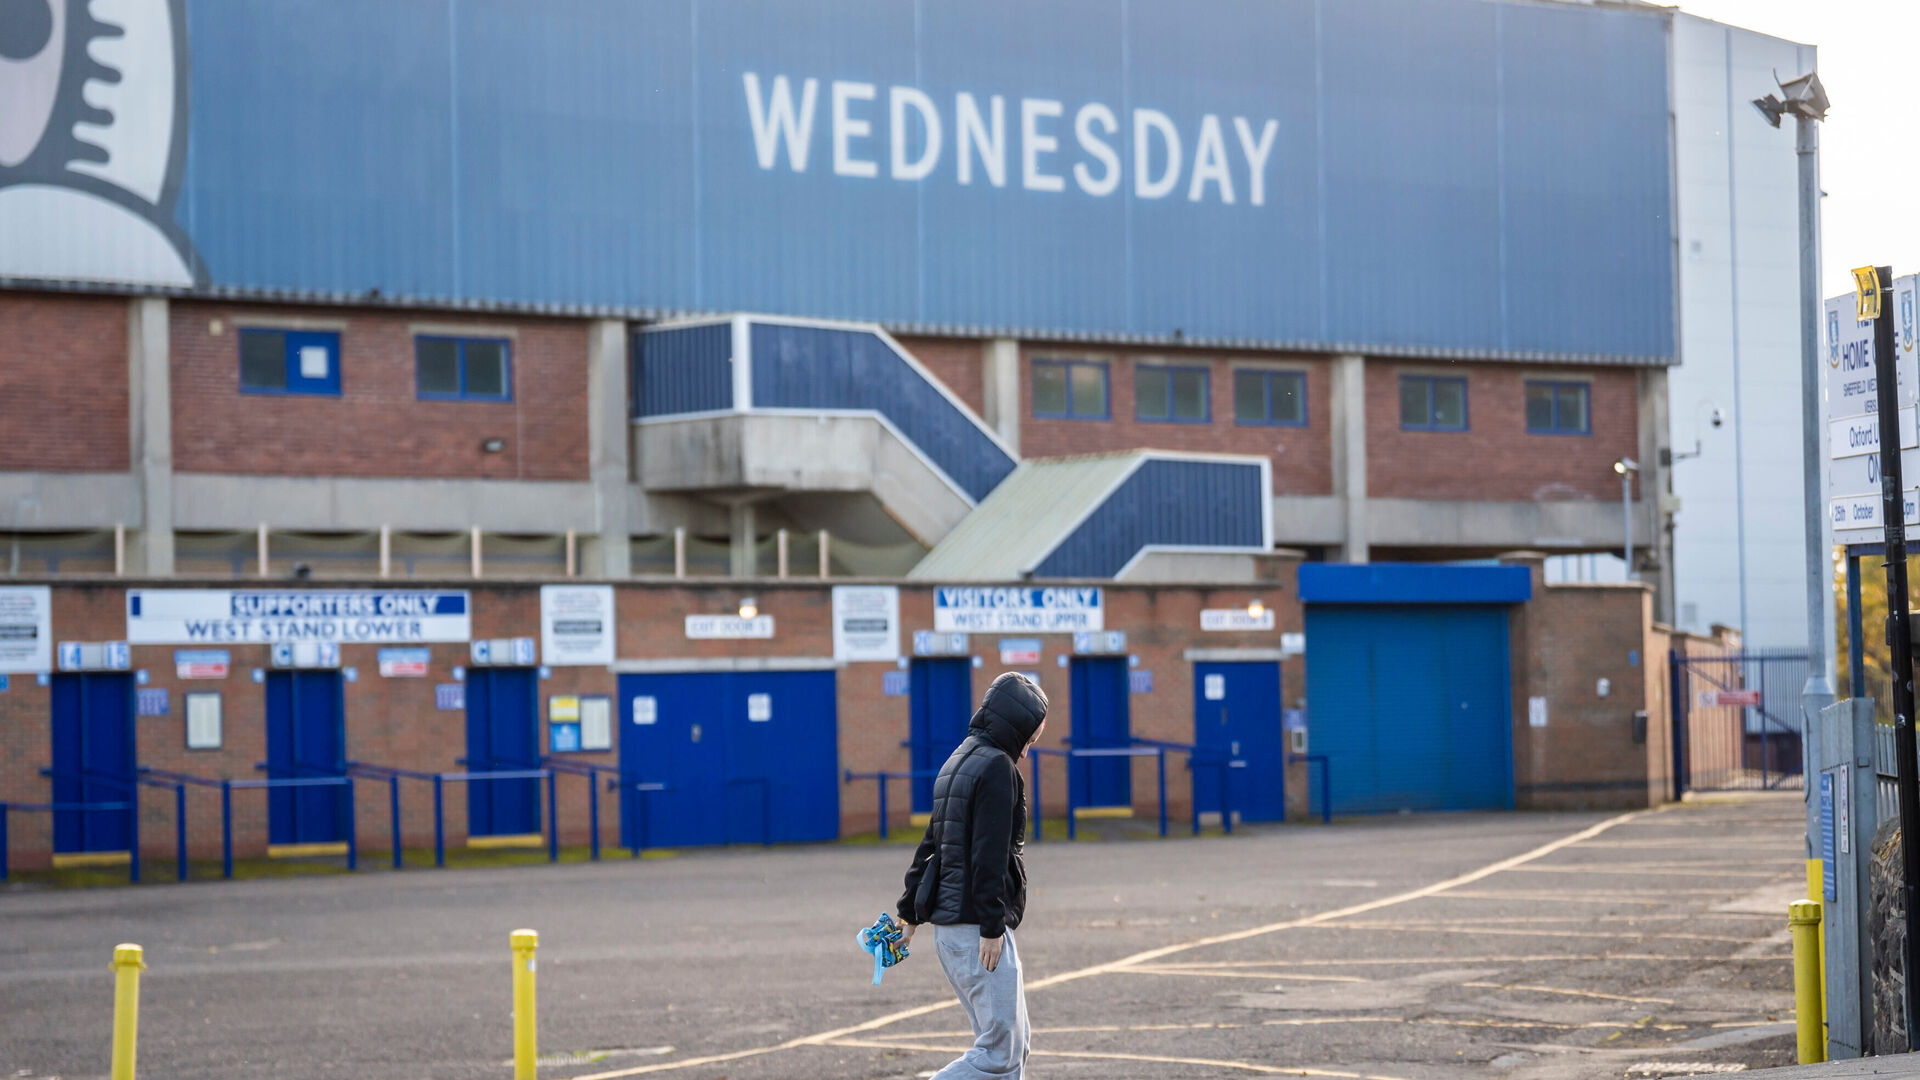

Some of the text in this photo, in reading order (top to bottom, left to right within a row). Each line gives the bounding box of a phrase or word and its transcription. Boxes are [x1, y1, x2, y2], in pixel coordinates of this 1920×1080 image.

[742, 71, 1279, 206] WEDNESDAY
[1841, 338, 1869, 372] HOME
[1849, 424, 1873, 448] Oxford
[1852, 503, 1873, 521] October
[233, 594, 439, 616] SUPPORTERS ONLY
[943, 586, 1095, 608] VISITORS ONLY
[185, 618, 421, 639] WEST STAND LOWER
[954, 612, 1087, 627] WEST STAND UPPER
